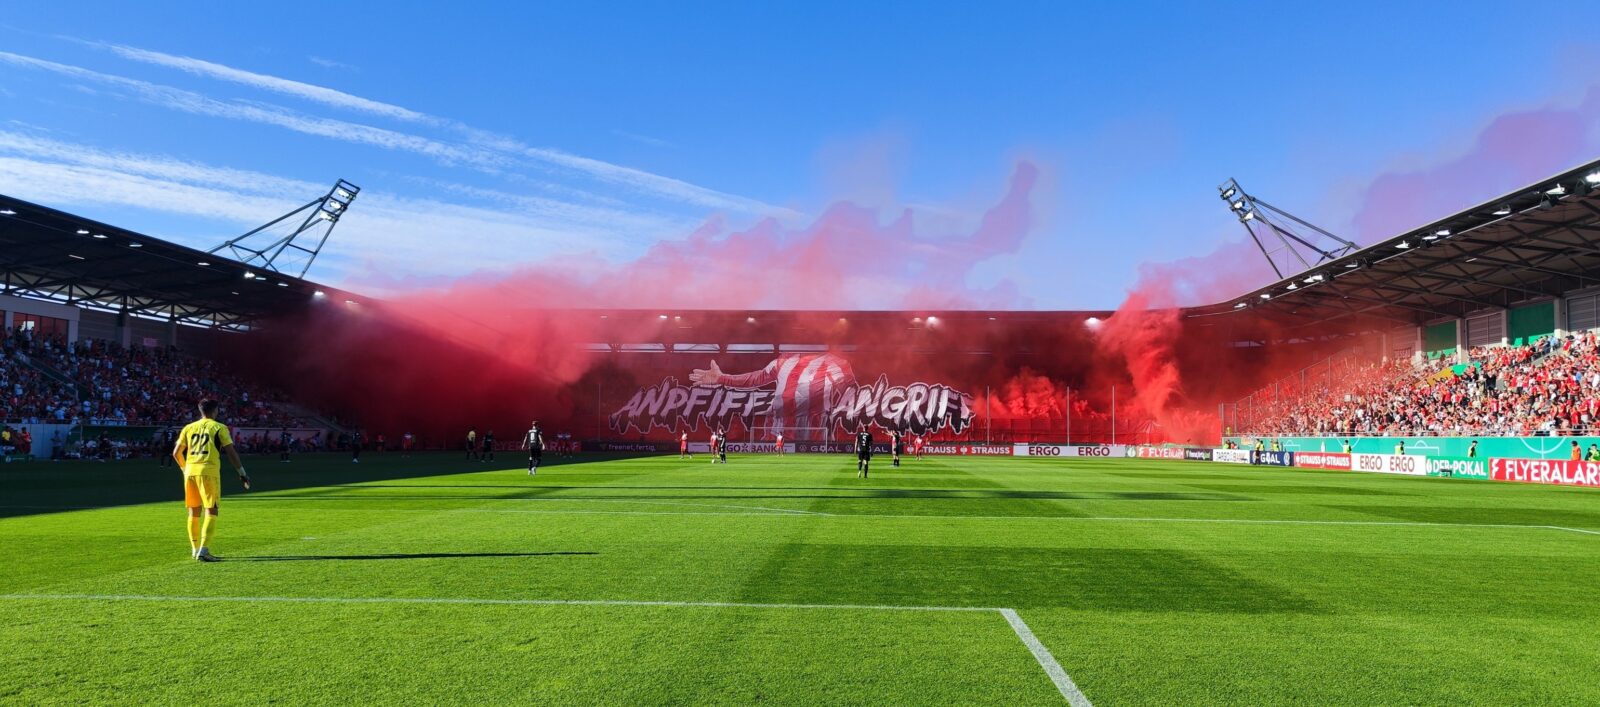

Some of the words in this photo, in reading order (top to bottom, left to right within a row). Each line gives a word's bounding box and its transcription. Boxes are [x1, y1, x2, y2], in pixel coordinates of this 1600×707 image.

[190, 433, 210, 455] 22
[706, 444, 741, 453] TGO
[919, 446, 957, 454] TRAUSS
[971, 446, 1010, 455] STRAUSS
[1028, 446, 1061, 456] ERGO
[1078, 446, 1110, 457] ERGO
[1299, 454, 1321, 465] STRAUSS
[1326, 455, 1350, 467] STRAUSS
[1359, 455, 1383, 470] ERGO
[1389, 456, 1415, 472] ERGO
[1505, 460, 1600, 485] FLYERALAR
